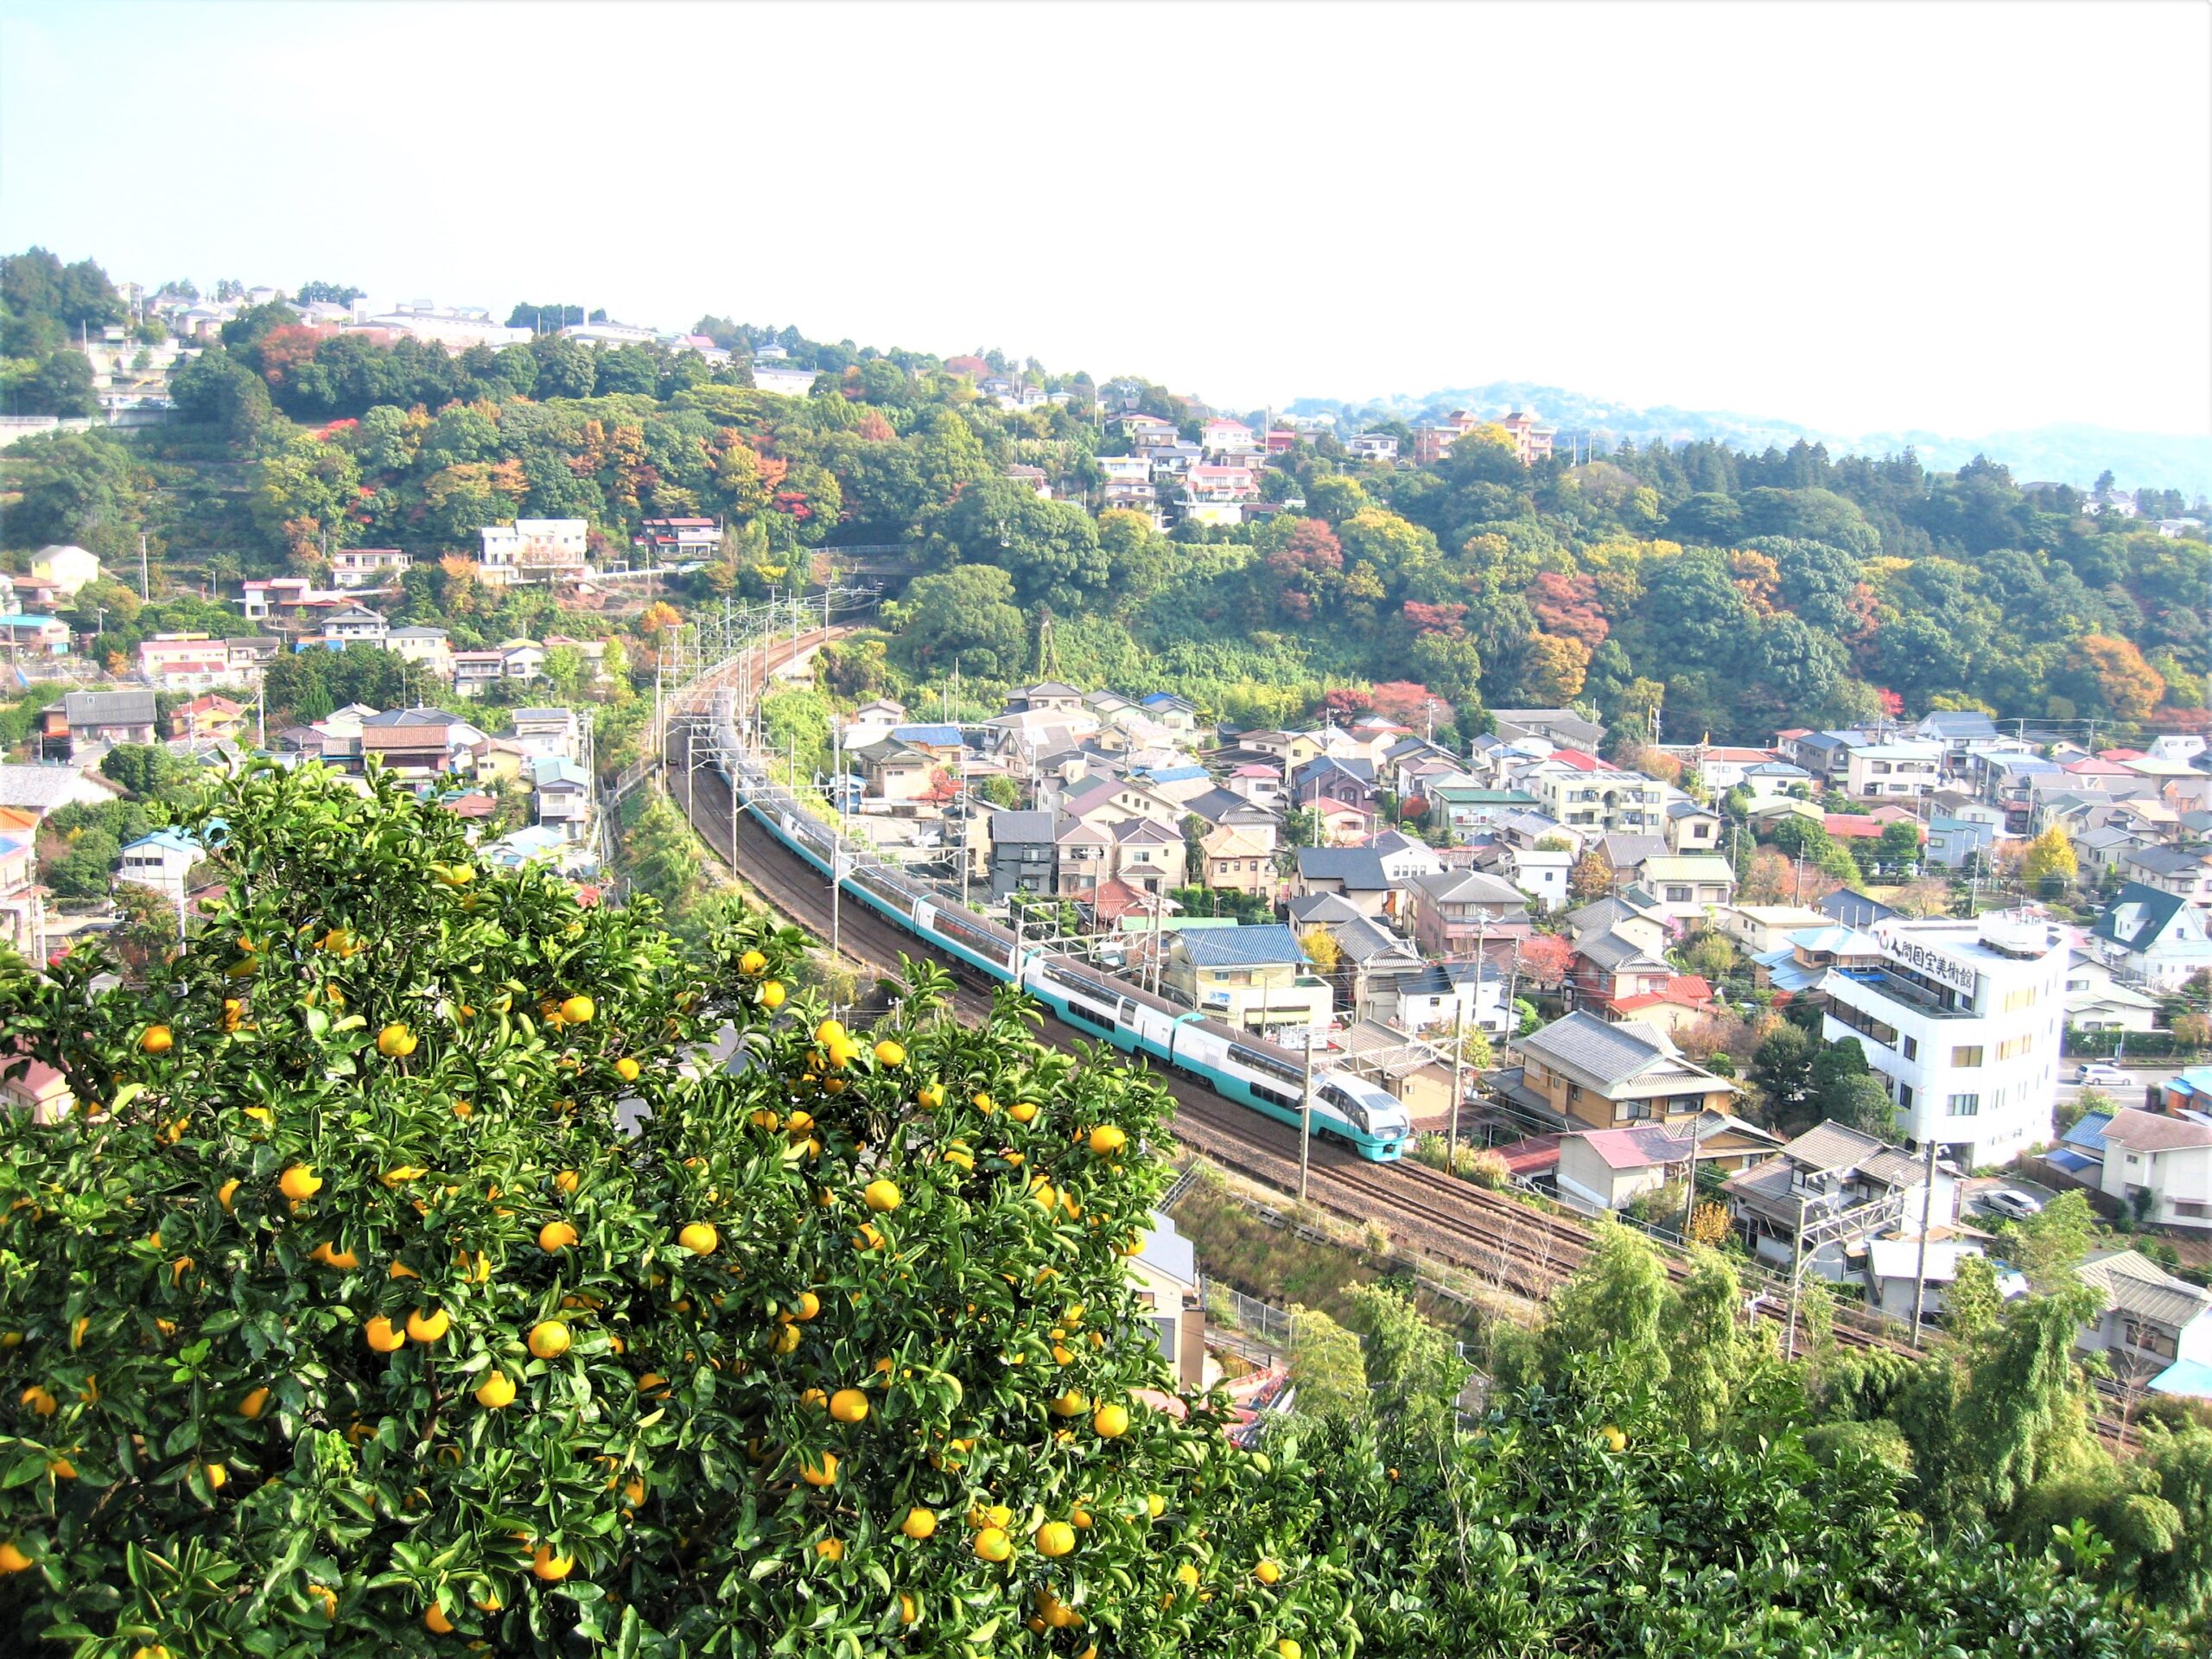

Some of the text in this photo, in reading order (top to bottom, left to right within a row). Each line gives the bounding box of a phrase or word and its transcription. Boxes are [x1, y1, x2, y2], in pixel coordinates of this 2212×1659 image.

[1891, 938, 1974, 988] 人間国宝美術館
